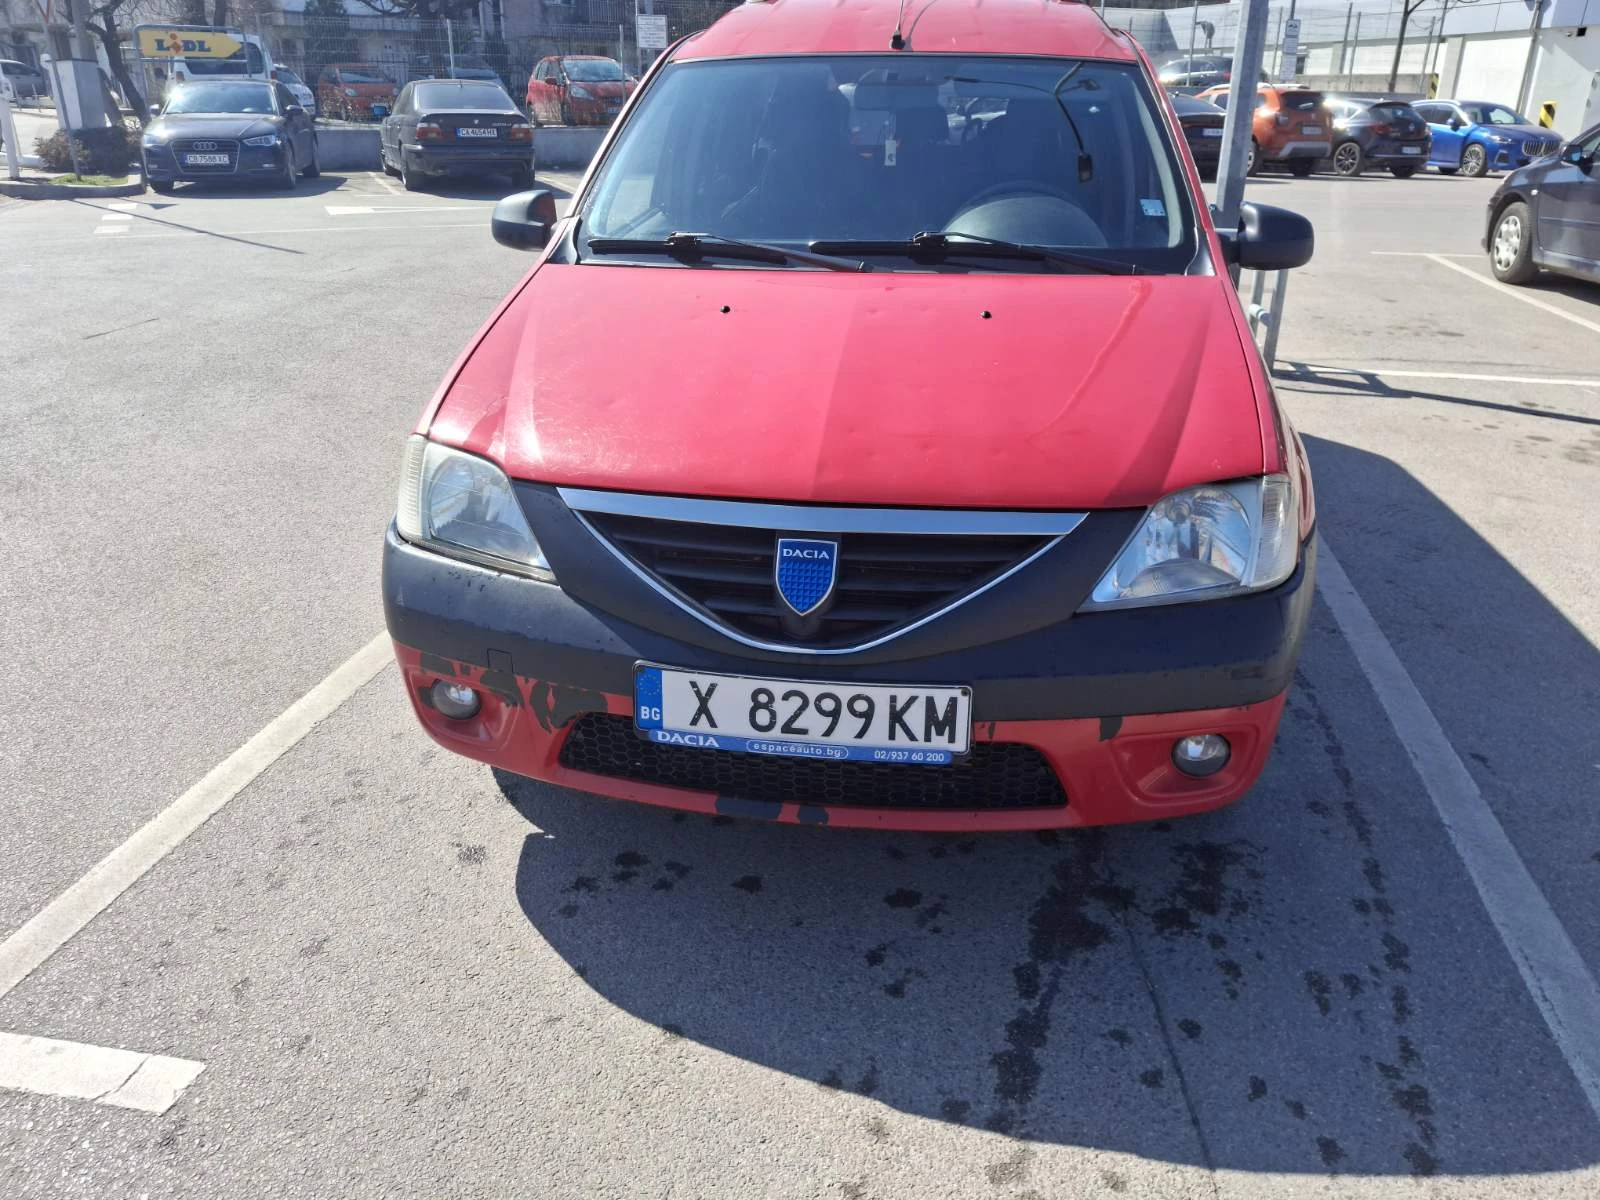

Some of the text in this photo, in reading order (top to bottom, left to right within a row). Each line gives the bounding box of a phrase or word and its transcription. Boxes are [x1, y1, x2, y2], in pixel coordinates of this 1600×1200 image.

[783, 548, 829, 559] DACIA
[689, 680, 718, 729] X
[640, 706, 661, 720] BG
[655, 731, 720, 747] DACIA
[874, 750, 945, 762] 02/937 60 200
